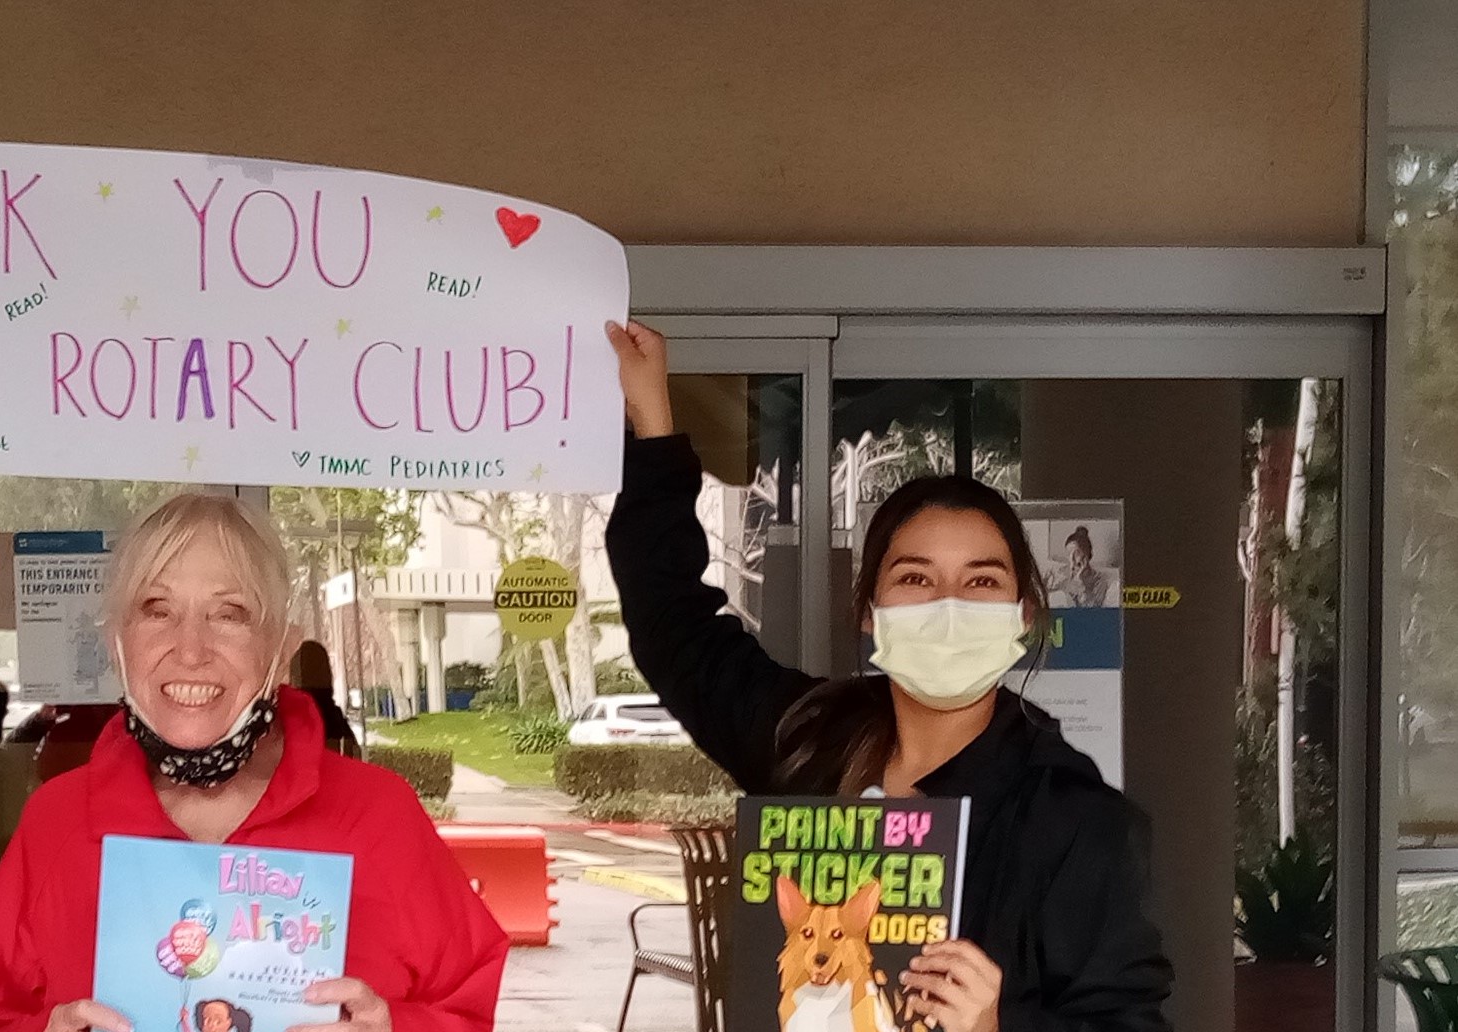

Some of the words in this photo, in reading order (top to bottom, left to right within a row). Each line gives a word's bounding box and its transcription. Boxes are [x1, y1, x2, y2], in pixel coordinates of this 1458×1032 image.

[173, 175, 371, 292] YOU
[427, 271, 482, 298] READ!
[5, 283, 49, 321] READ!
[49, 332, 310, 432] ROTARY
[353, 325, 573, 448] CLUB!
[317, 454, 372, 477] TMMC
[391, 454, 505, 479] PEDIATRICS
[21, 569, 43, 580] THIS
[46, 568, 98, 580] ENTRANCE
[503, 577, 568, 587] AUTOMATIC
[21, 583, 91, 595] TEMPORARILY
[497, 592, 574, 607] CAUTION
[518, 613, 552, 623] DOOR
[759, 805, 883, 850] PAINT
[883, 810, 932, 847] BY
[742, 851, 945, 908] STICKER
[226, 901, 336, 954] Alright
[869, 913, 949, 945] DOGS
